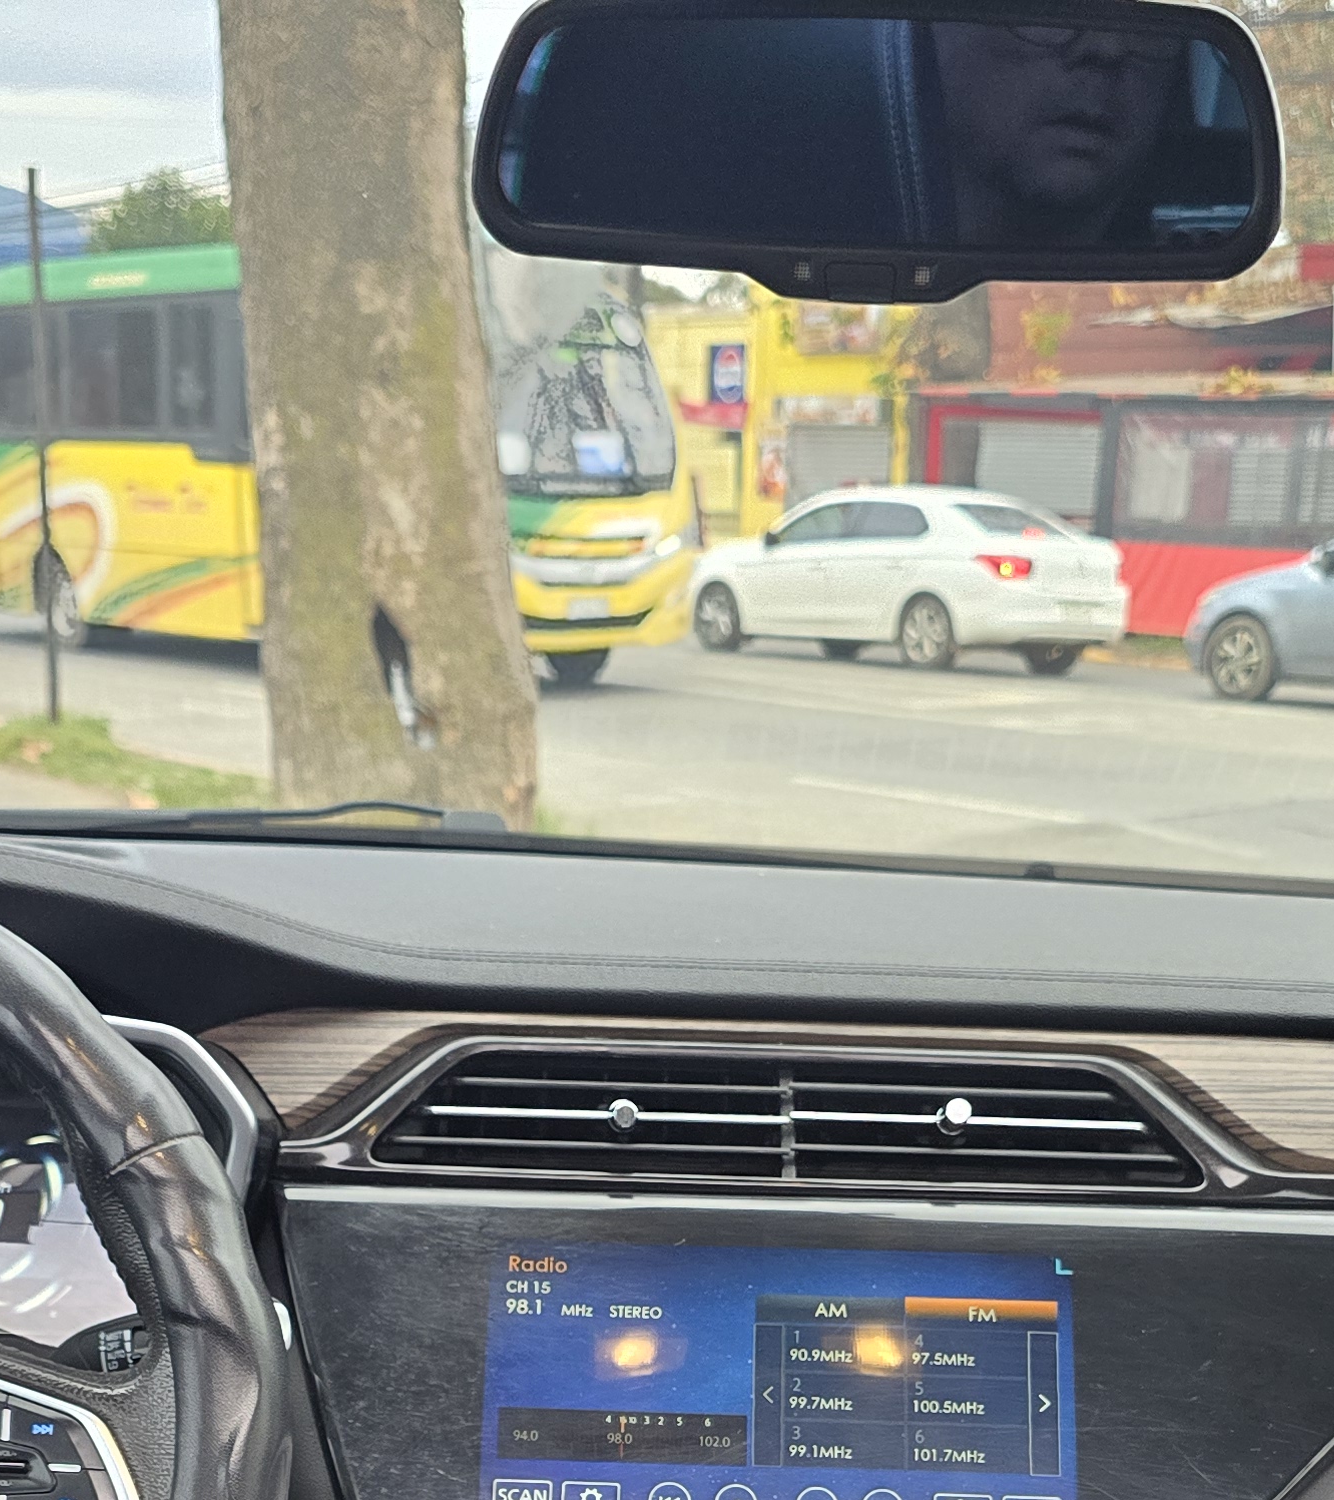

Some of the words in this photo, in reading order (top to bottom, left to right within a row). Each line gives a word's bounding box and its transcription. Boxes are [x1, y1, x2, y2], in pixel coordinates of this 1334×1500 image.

[508, 1255, 568, 1274] Radio
[505, 1280, 529, 1294] CH
[533, 1281, 552, 1295] 15
[505, 1298, 543, 1316] 98.1
[560, 1304, 594, 1318] MHz
[609, 1305, 663, 1320] STEREO
[814, 1303, 848, 1318] AM
[968, 1306, 997, 1323] FM
[793, 1330, 801, 1344] 1
[914, 1334, 924, 1348] 4
[789, 1348, 854, 1364] 90.9MHz
[911, 1352, 976, 1368] 97.5MHz
[792, 1378, 802, 1392] 2
[914, 1382, 924, 1396] 5
[788, 1396, 854, 1411] 99.7MHz
[913, 1399, 986, 1415] 100.5MHz
[512, 1430, 539, 1442] 94.0
[606, 1433, 633, 1445] 98.0
[699, 1435, 731, 1448] 102.0
[792, 1426, 801, 1440] 3
[915, 1430, 925, 1444] 6
[788, 1445, 853, 1460] 99.1MHz
[913, 1448, 986, 1464] 101.7MHz
